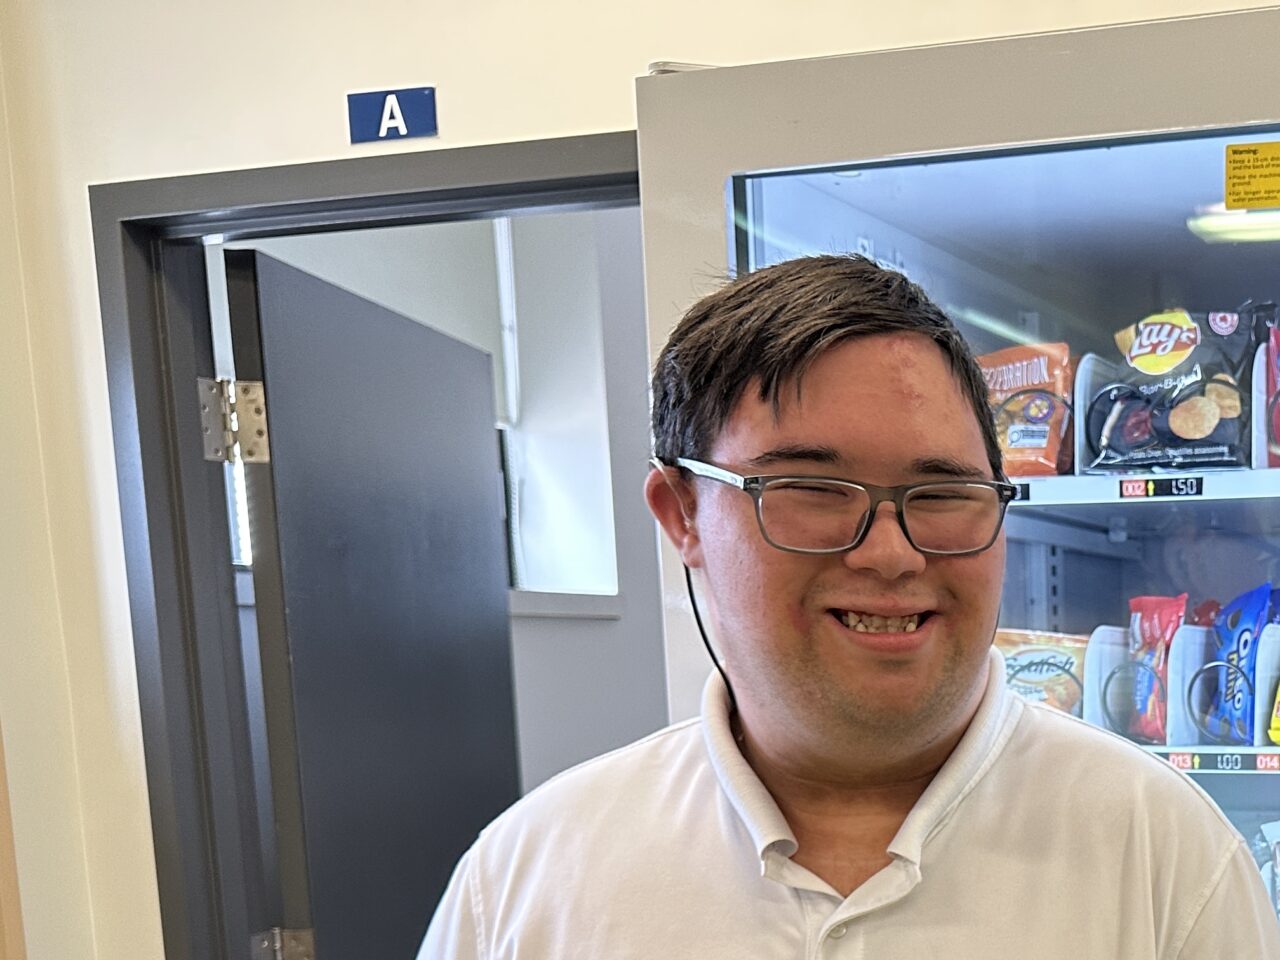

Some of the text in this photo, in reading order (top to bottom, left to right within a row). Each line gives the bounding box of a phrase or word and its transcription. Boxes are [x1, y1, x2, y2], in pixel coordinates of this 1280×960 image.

[379, 94, 408, 137] A
[1130, 323, 1196, 356] Lay's
[1122, 481, 1146, 496] 002
[1169, 754, 1191, 769] 013
[1256, 754, 1280, 769] 014
